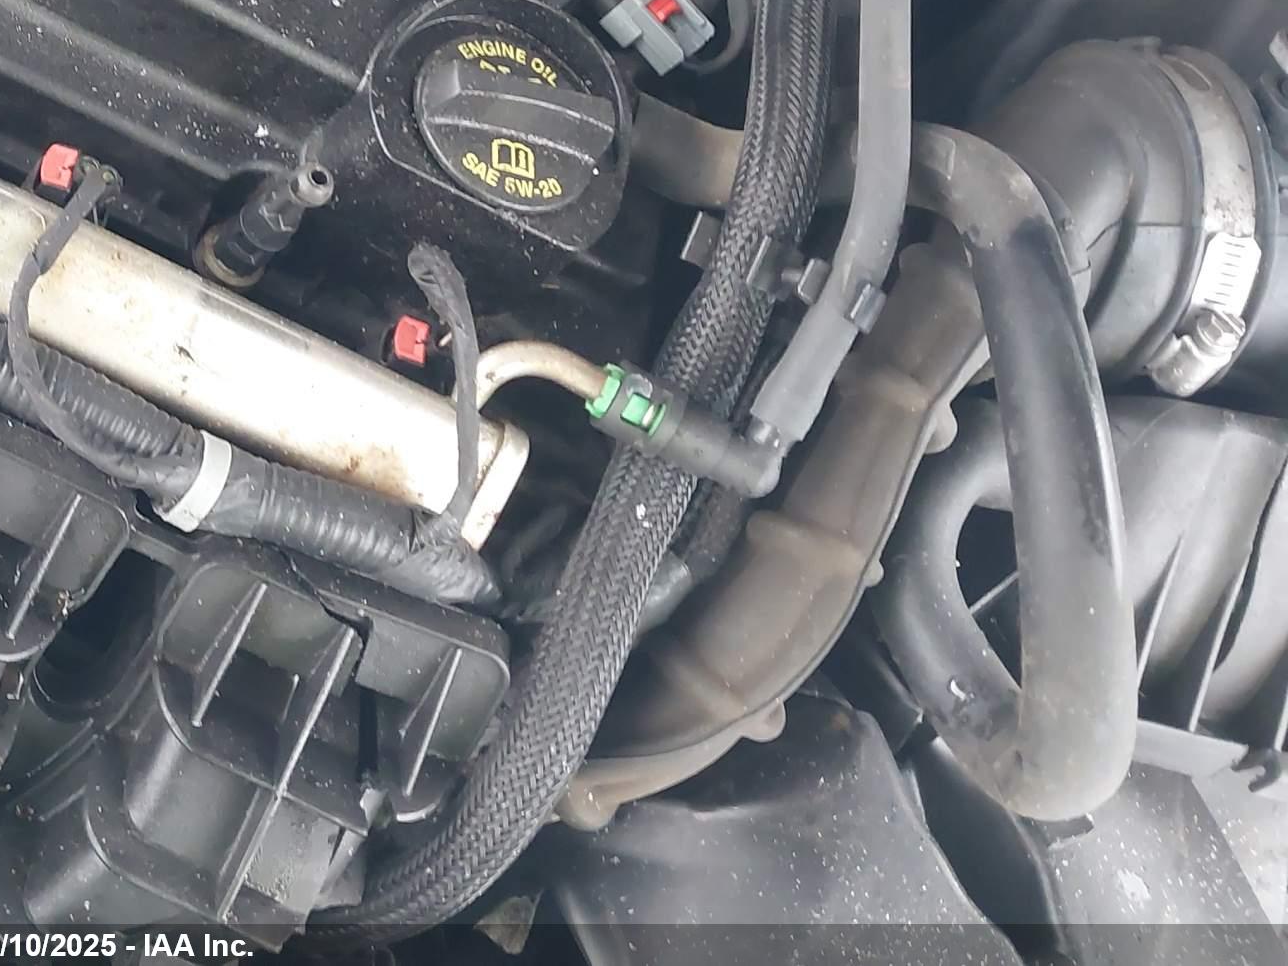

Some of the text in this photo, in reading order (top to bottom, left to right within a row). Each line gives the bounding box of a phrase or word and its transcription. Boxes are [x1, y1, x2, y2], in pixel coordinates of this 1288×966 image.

[458, 40, 559, 88] ENGINE OIL
[462, 152, 562, 199] SAE 5W-20
